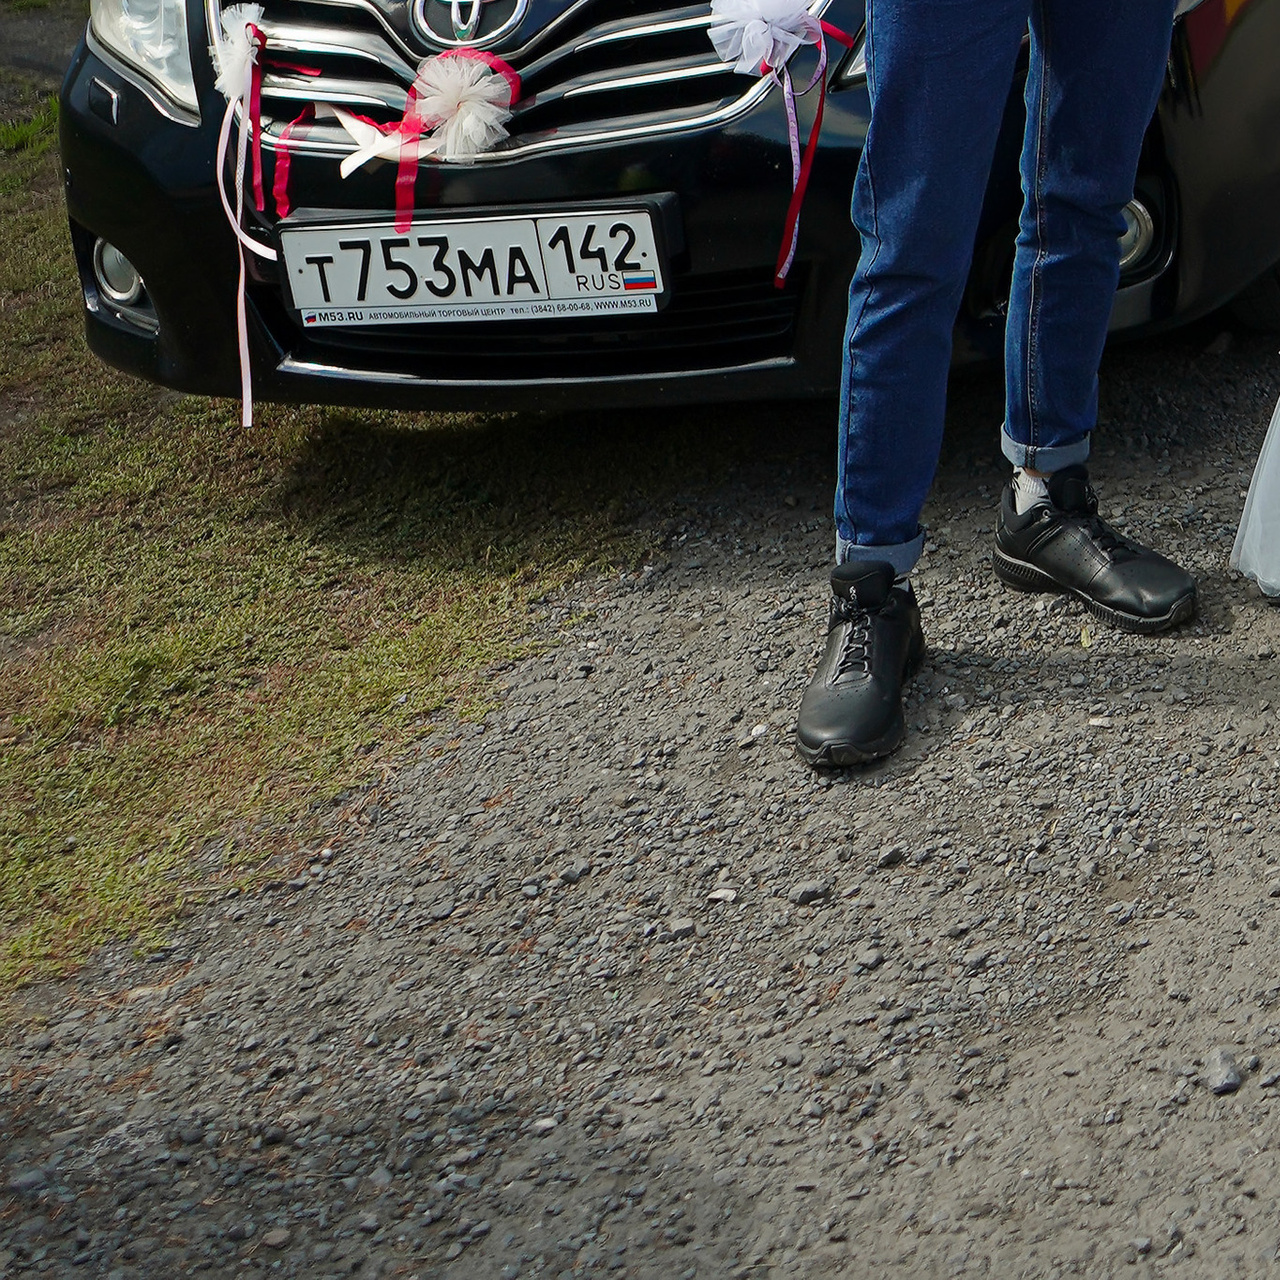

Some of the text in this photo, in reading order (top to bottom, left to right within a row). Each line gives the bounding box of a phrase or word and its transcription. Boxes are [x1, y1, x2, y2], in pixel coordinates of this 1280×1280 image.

[548, 223, 641, 274] 142
[577, 272, 621, 292] RUS
[368, 309, 437, 320] АВТОМОБИЛЬНЫЙ
[438, 307, 480, 318] ТОРГОВЫЙ
[481, 308, 506, 316] ЦЕНТР
[531, 303, 555, 314] (3842)
